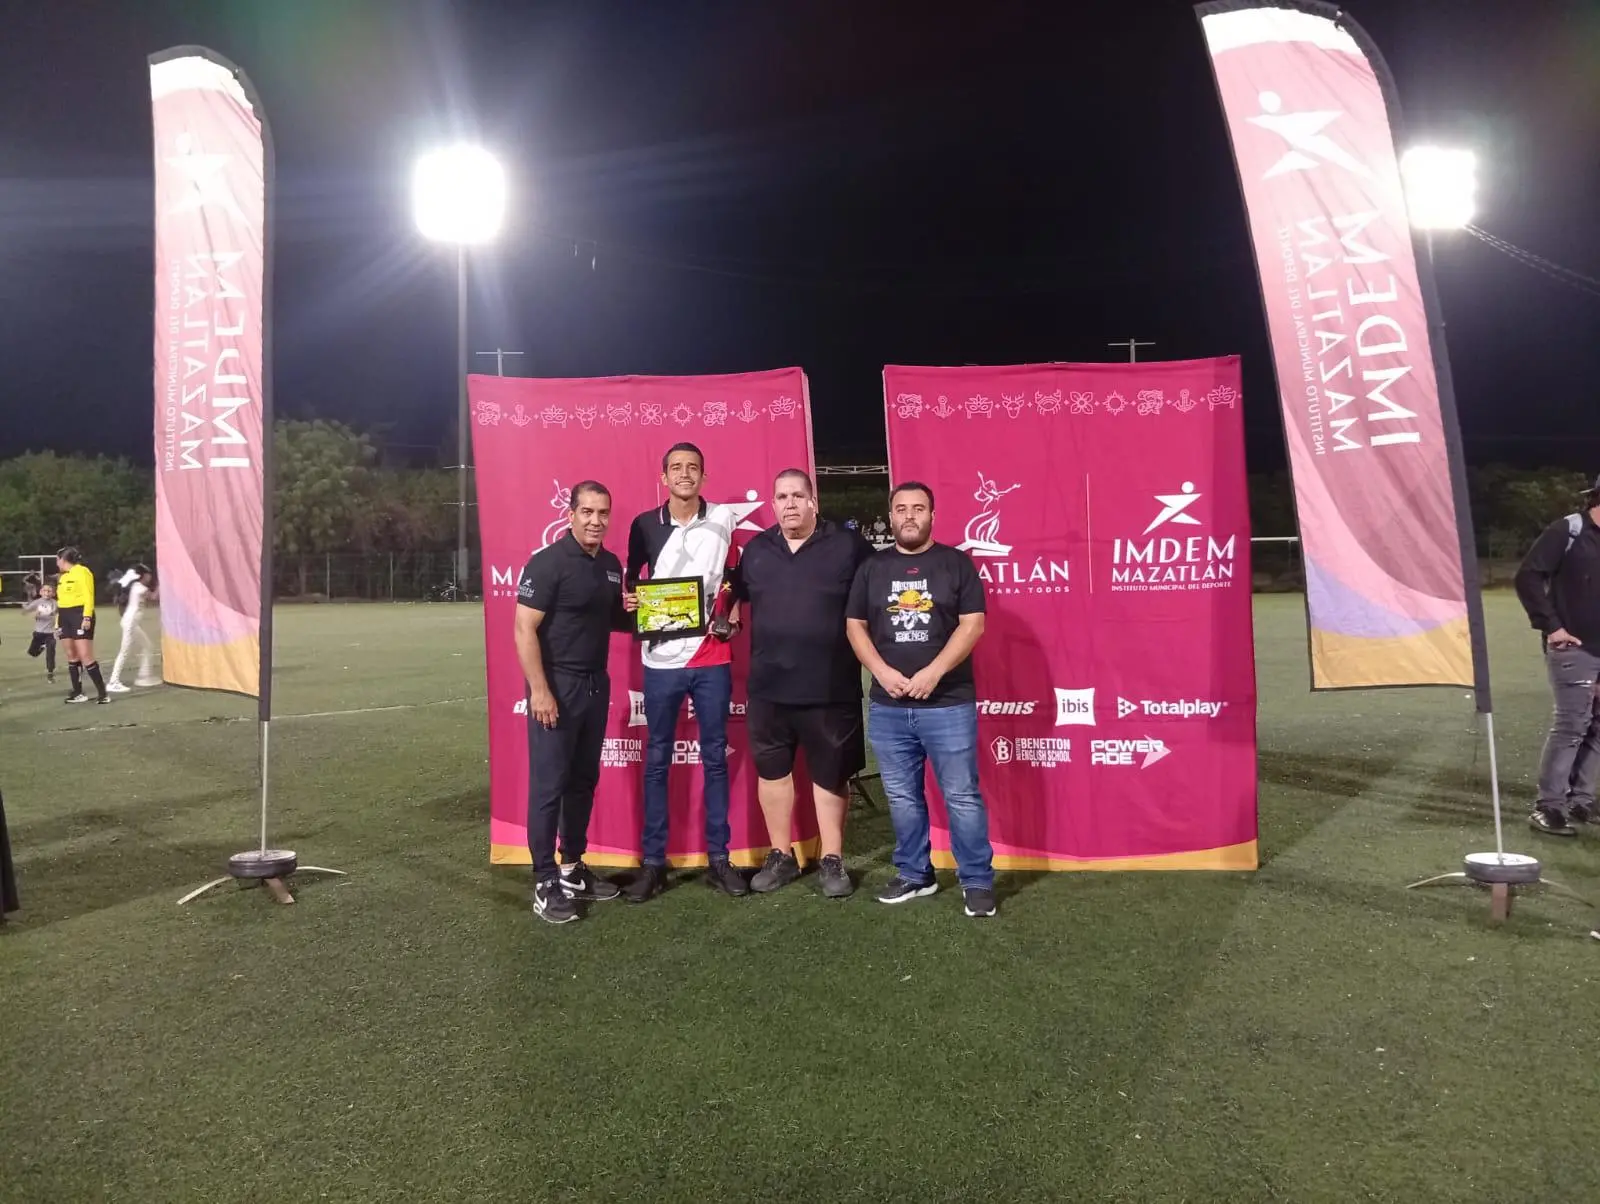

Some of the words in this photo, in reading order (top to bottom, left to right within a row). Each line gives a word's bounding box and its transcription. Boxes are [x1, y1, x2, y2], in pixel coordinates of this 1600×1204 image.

[1113, 534, 1235, 564] IMDEM
[978, 556, 1069, 583] ATLÁN
[1112, 560, 1233, 583] MAZATLÁN
[1028, 585, 1070, 594] TODOS
[1111, 584, 1148, 592] INSTITUTO
[976, 699, 1035, 715] rtenis
[1062, 699, 1089, 713] ibis
[1140, 698, 1222, 718] Totalplay
[602, 738, 642, 750] ENETTON
[1021, 738, 1071, 750] BENETTON
[1090, 739, 1164, 753] POWER
[619, 750, 642, 762] SCHOOL
[1021, 749, 1046, 761] ENGLISH
[1047, 750, 1072, 762] SCHOOL
